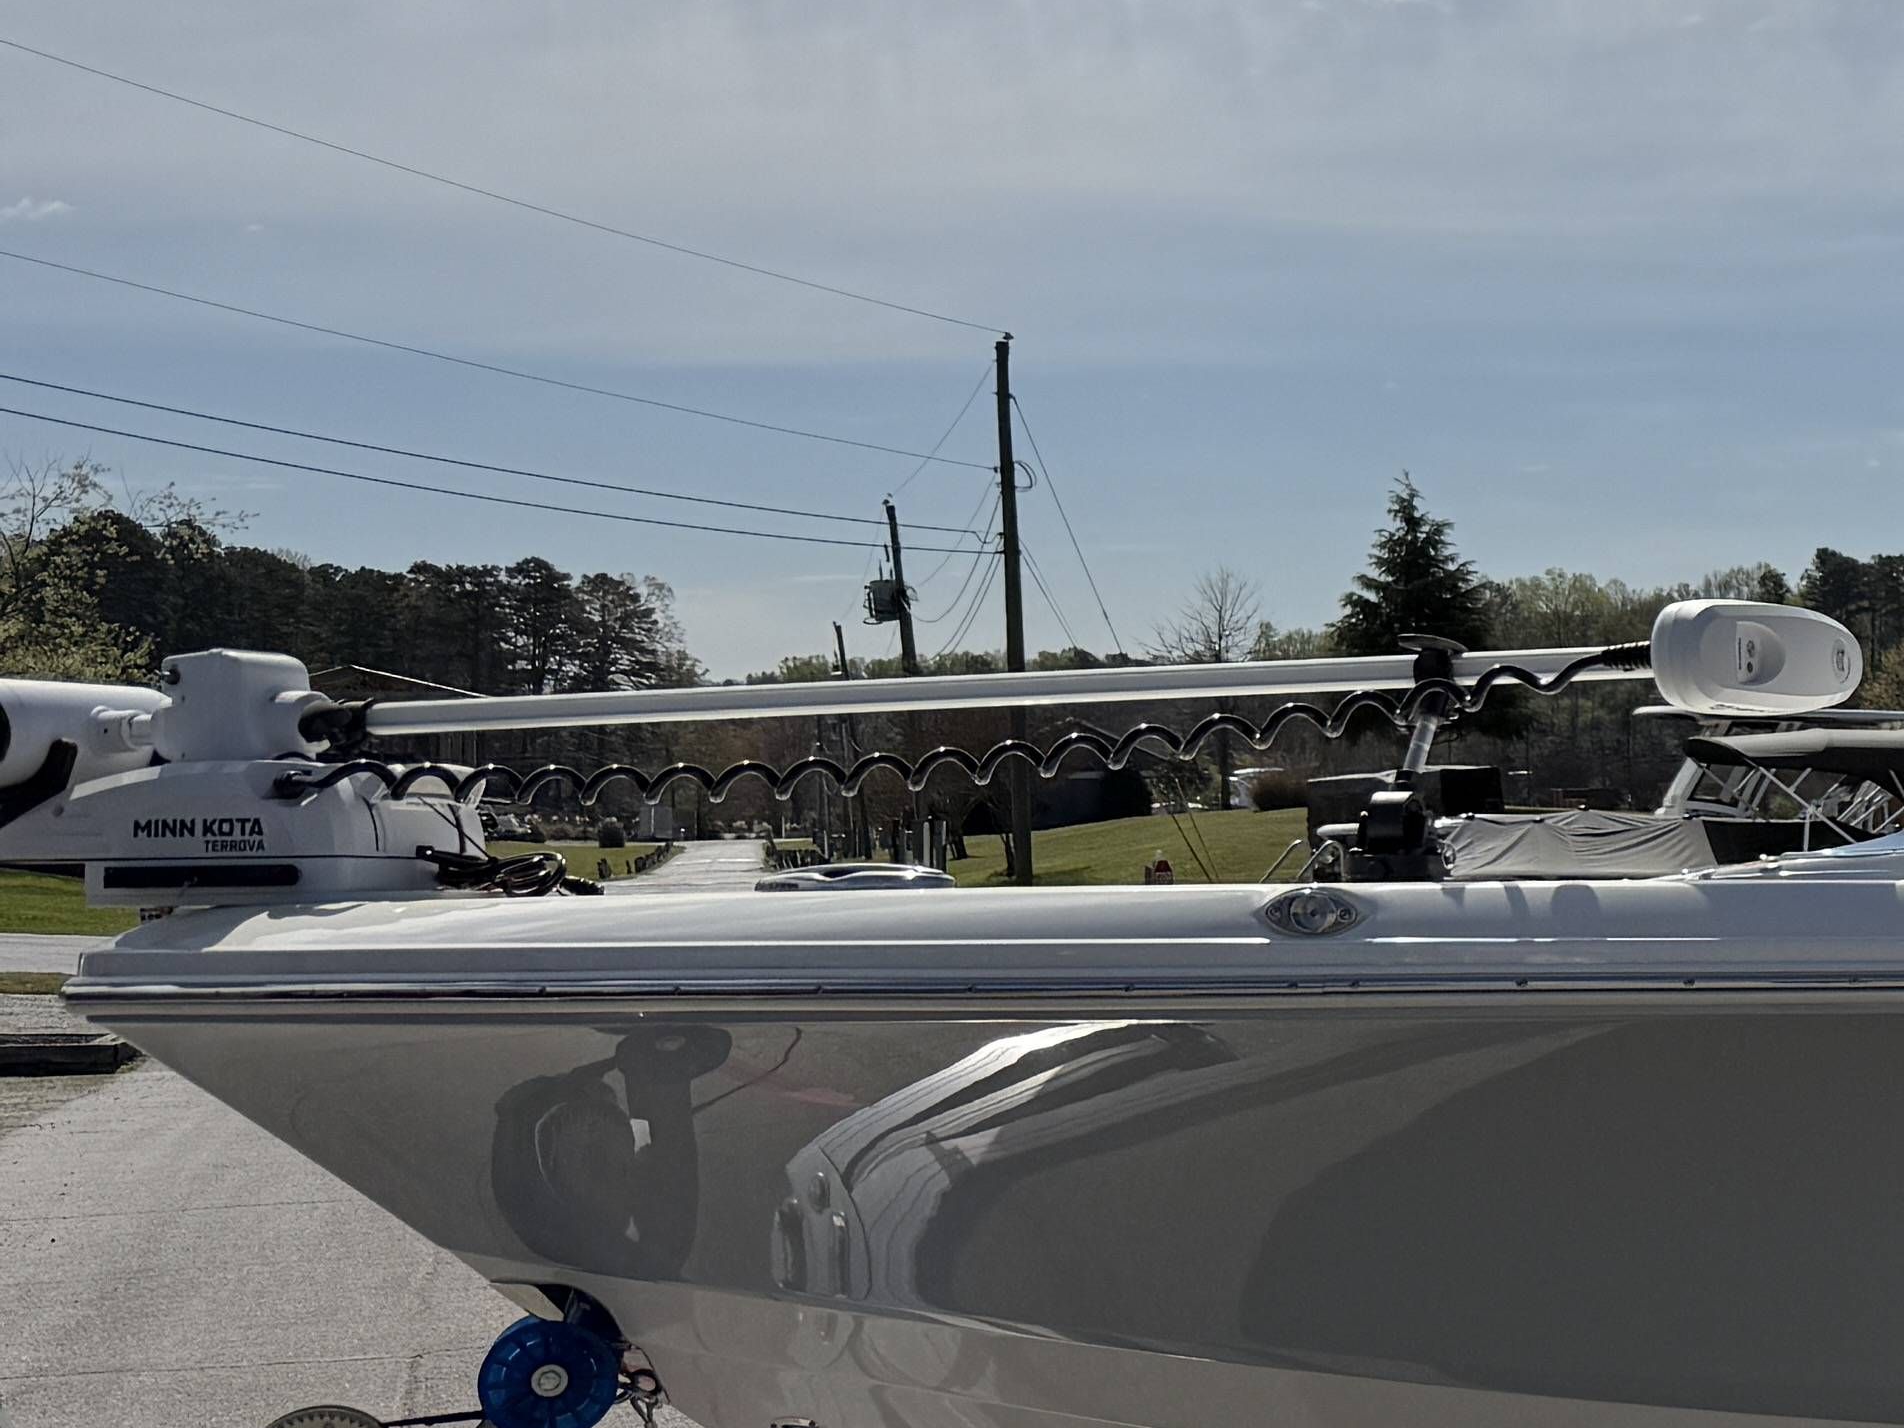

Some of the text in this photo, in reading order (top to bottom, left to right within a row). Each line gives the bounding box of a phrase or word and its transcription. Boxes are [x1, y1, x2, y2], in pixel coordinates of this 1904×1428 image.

[133, 818, 264, 838] MINN KOTA
[204, 839, 265, 853] TERROVA
